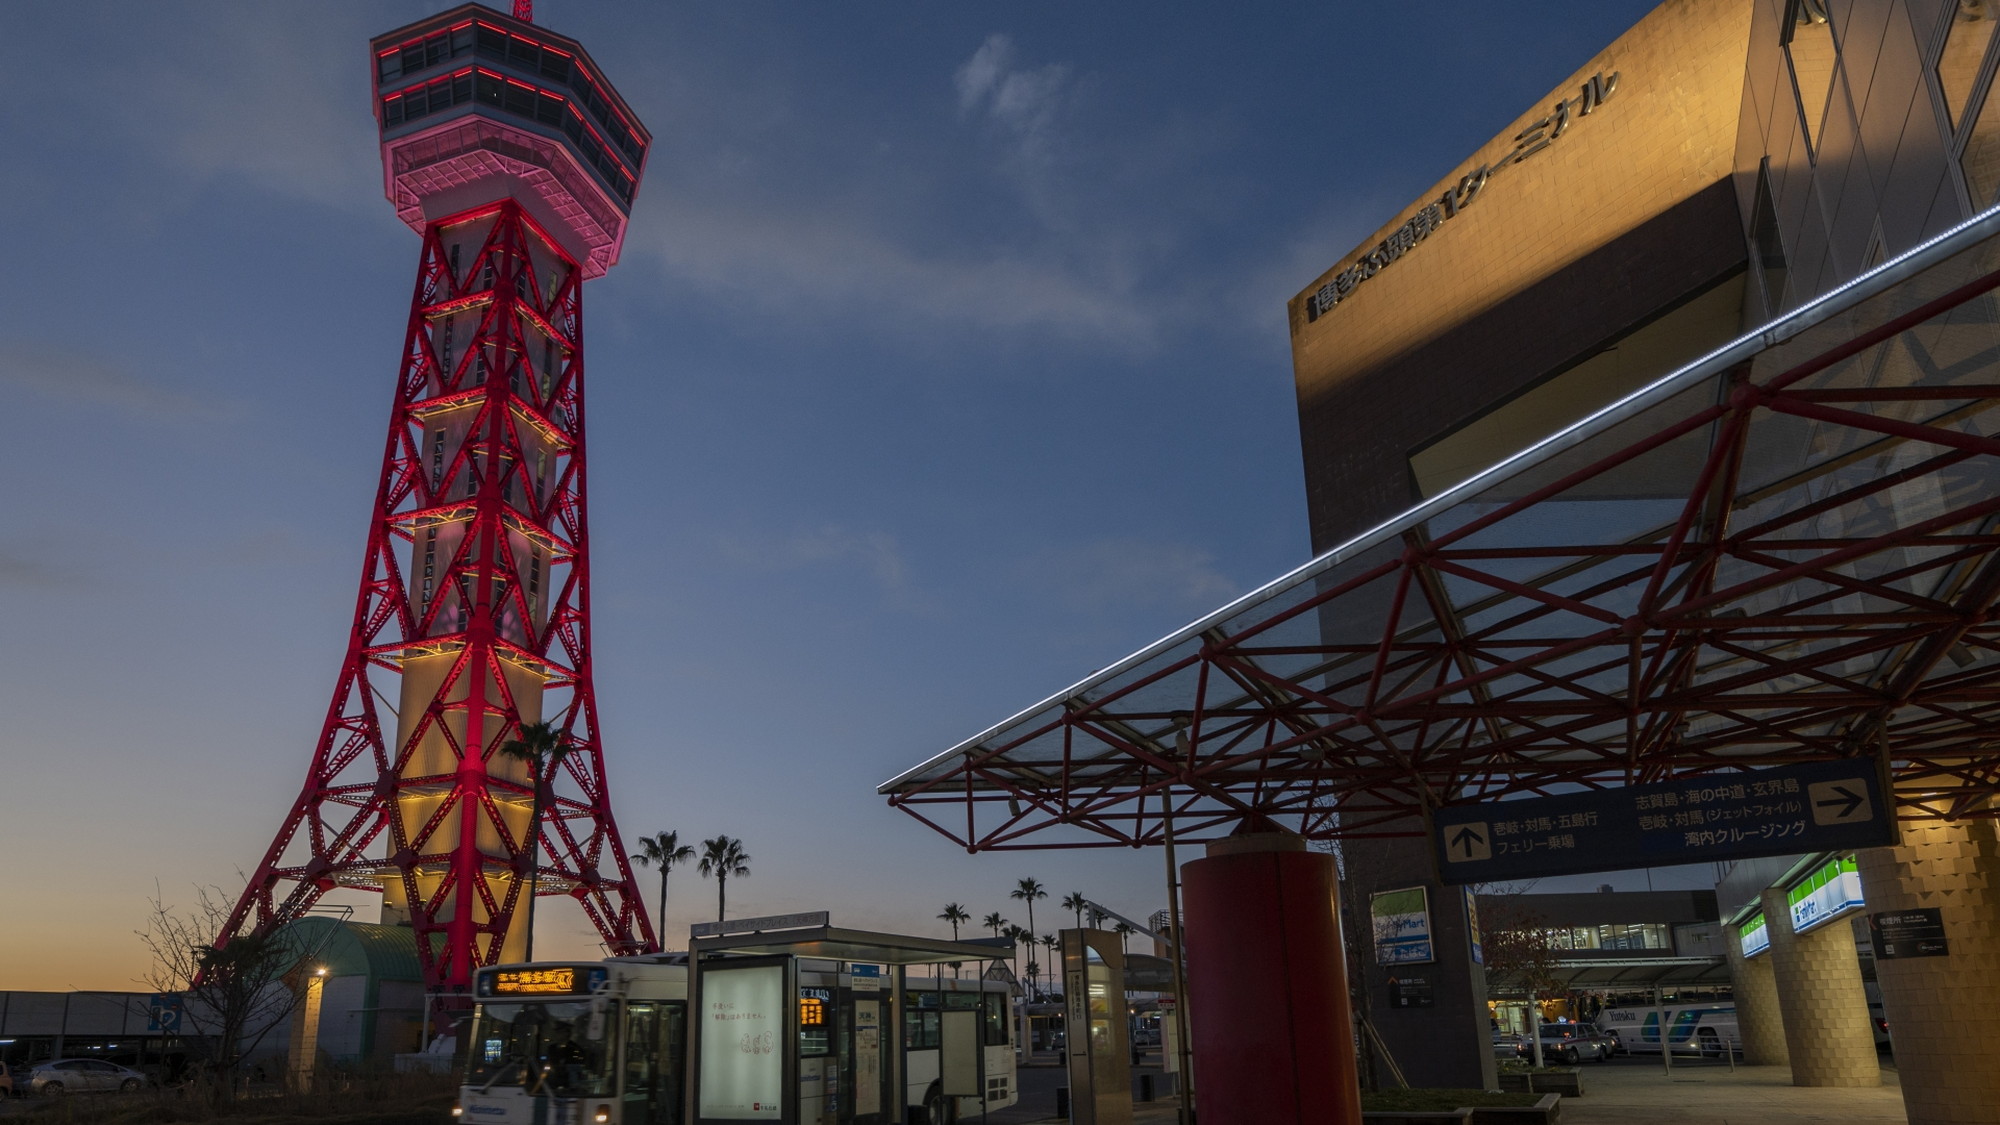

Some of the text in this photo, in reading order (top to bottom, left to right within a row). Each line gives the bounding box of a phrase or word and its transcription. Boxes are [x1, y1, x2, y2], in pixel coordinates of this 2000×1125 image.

[1313, 70, 1620, 320] 博多ふ頭第1ターミナル
[1635, 778, 1800, 810] 志賀島・海の中道・玄界島
[1493, 811, 1599, 837] 壱岐・対馬・五島行
[1684, 819, 1807, 847] 湾内クルージング
[1496, 834, 1575, 855] フェリー乗場
[1608, 1010, 1637, 1022] Yutoku
